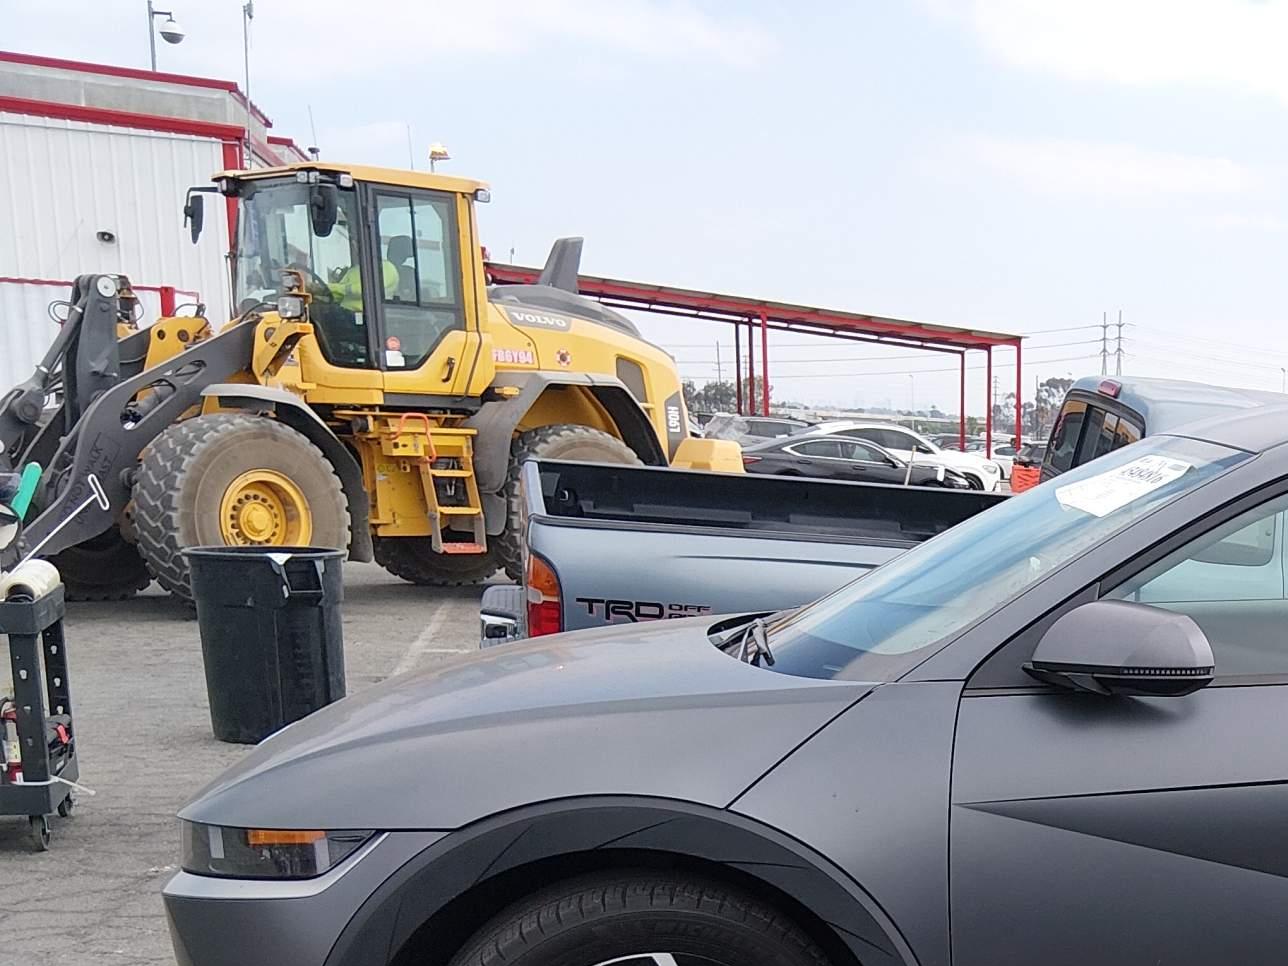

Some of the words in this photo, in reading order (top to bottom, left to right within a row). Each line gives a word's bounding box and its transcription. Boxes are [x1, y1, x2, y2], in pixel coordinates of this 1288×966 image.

[511, 311, 566, 327] VOLVO
[667, 406, 680, 432] L90H
[576, 597, 665, 622] TRD
[668, 603, 711, 613] OFF
